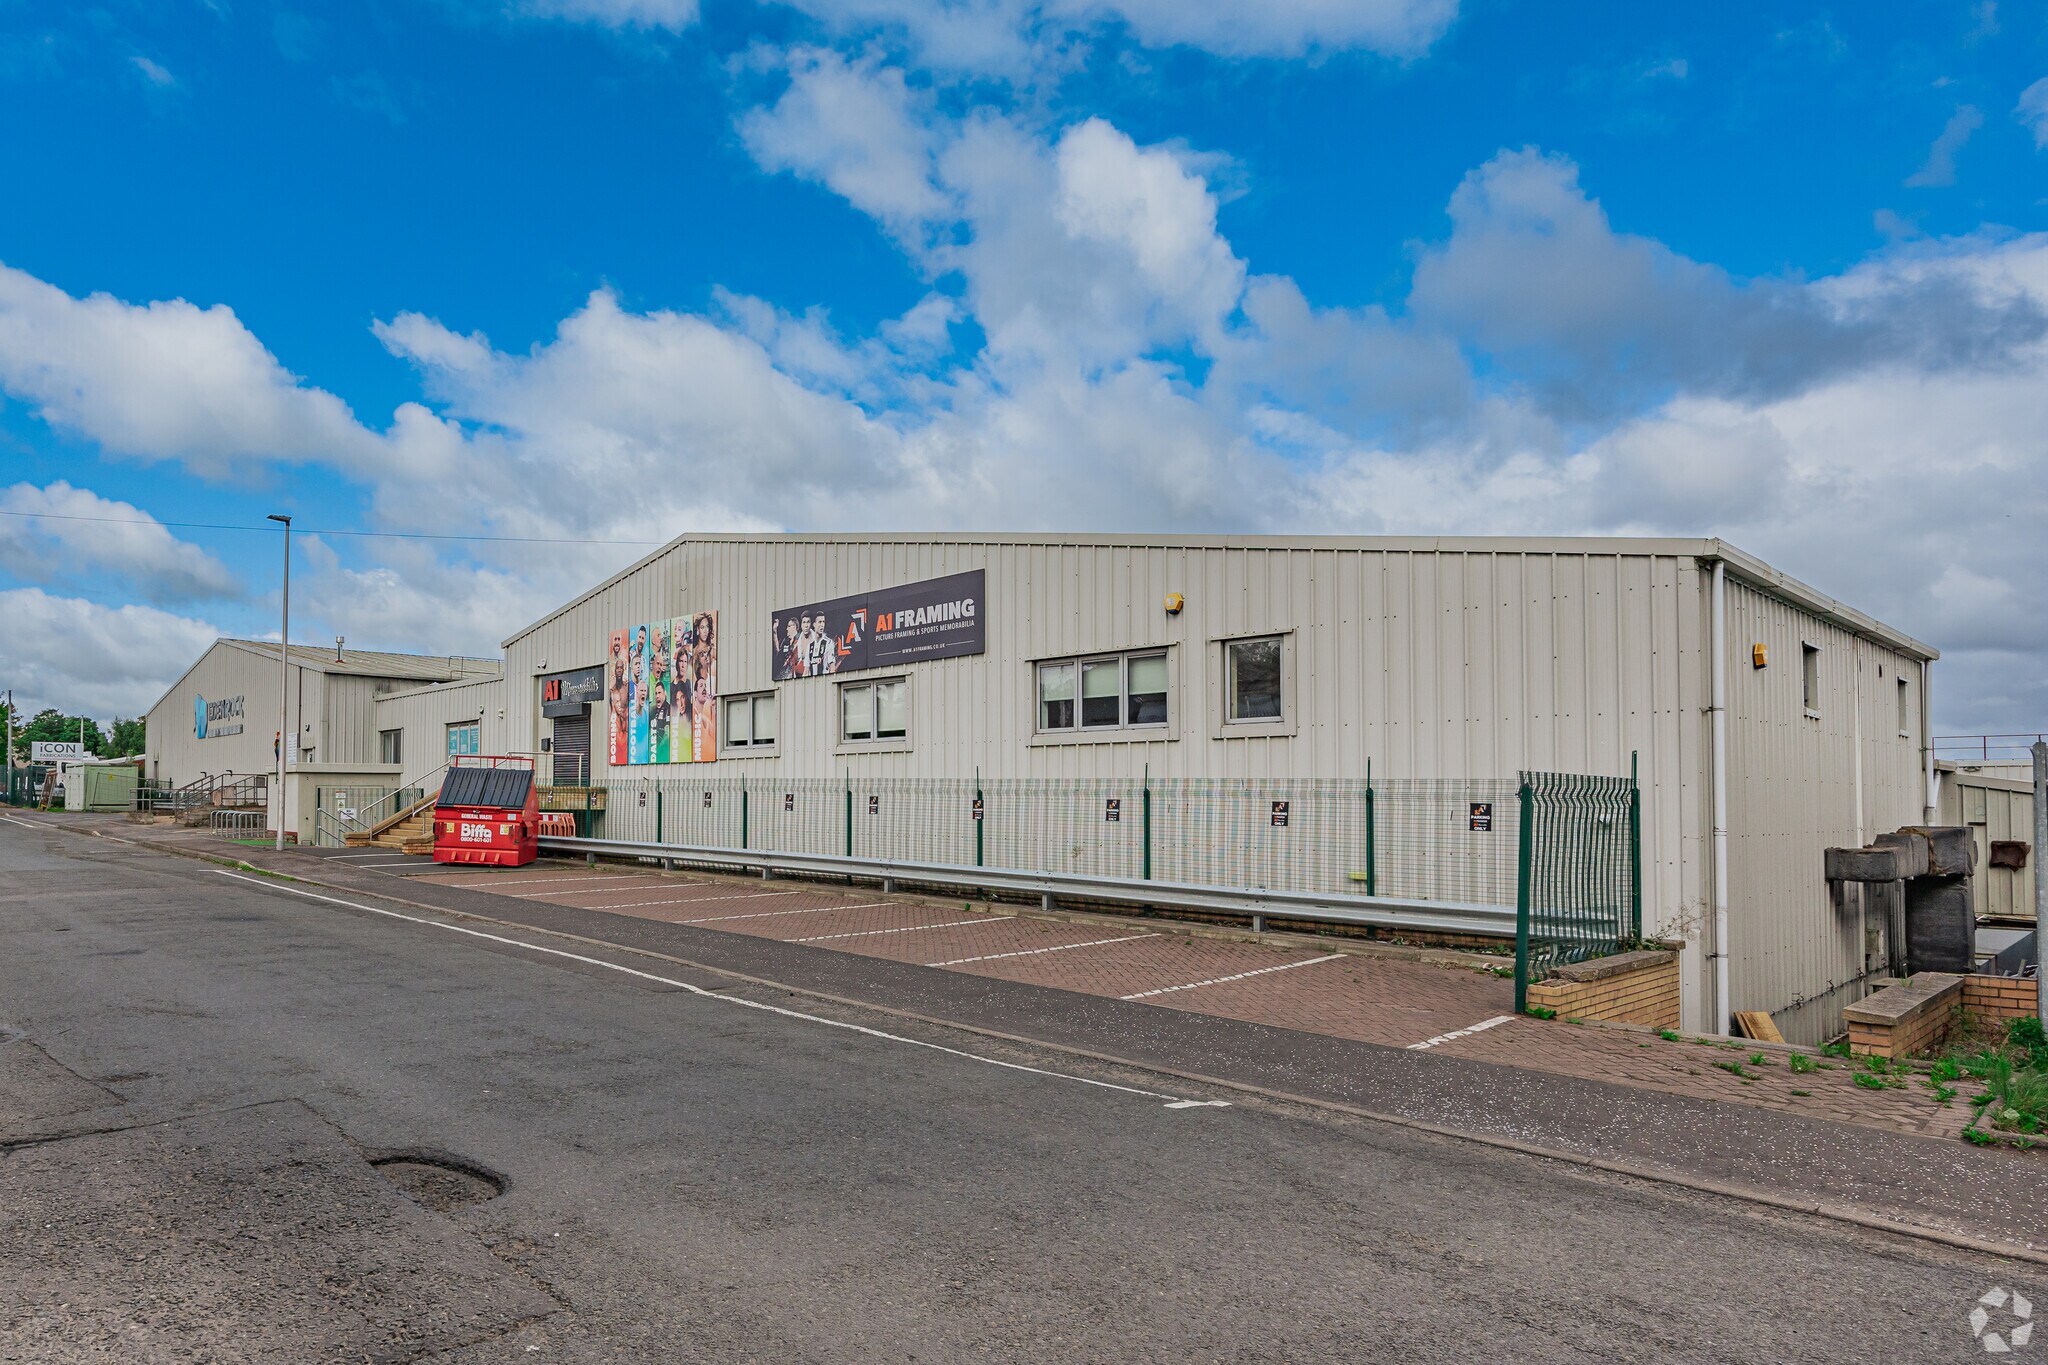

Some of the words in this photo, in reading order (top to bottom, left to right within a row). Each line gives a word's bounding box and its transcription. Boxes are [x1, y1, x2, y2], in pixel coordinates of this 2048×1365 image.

[875, 612, 893, 632] A1
[895, 598, 975, 629] FRAMING
[875, 632, 894, 642] PICTURE
[894, 629, 915, 639] FRAMING
[920, 625, 939, 635] SPORTS
[940, 619, 975, 631] MEMORABILIA
[544, 679, 559, 701] A1
[694, 713, 702, 761] MUSIC
[460, 823, 492, 838] Biffa
